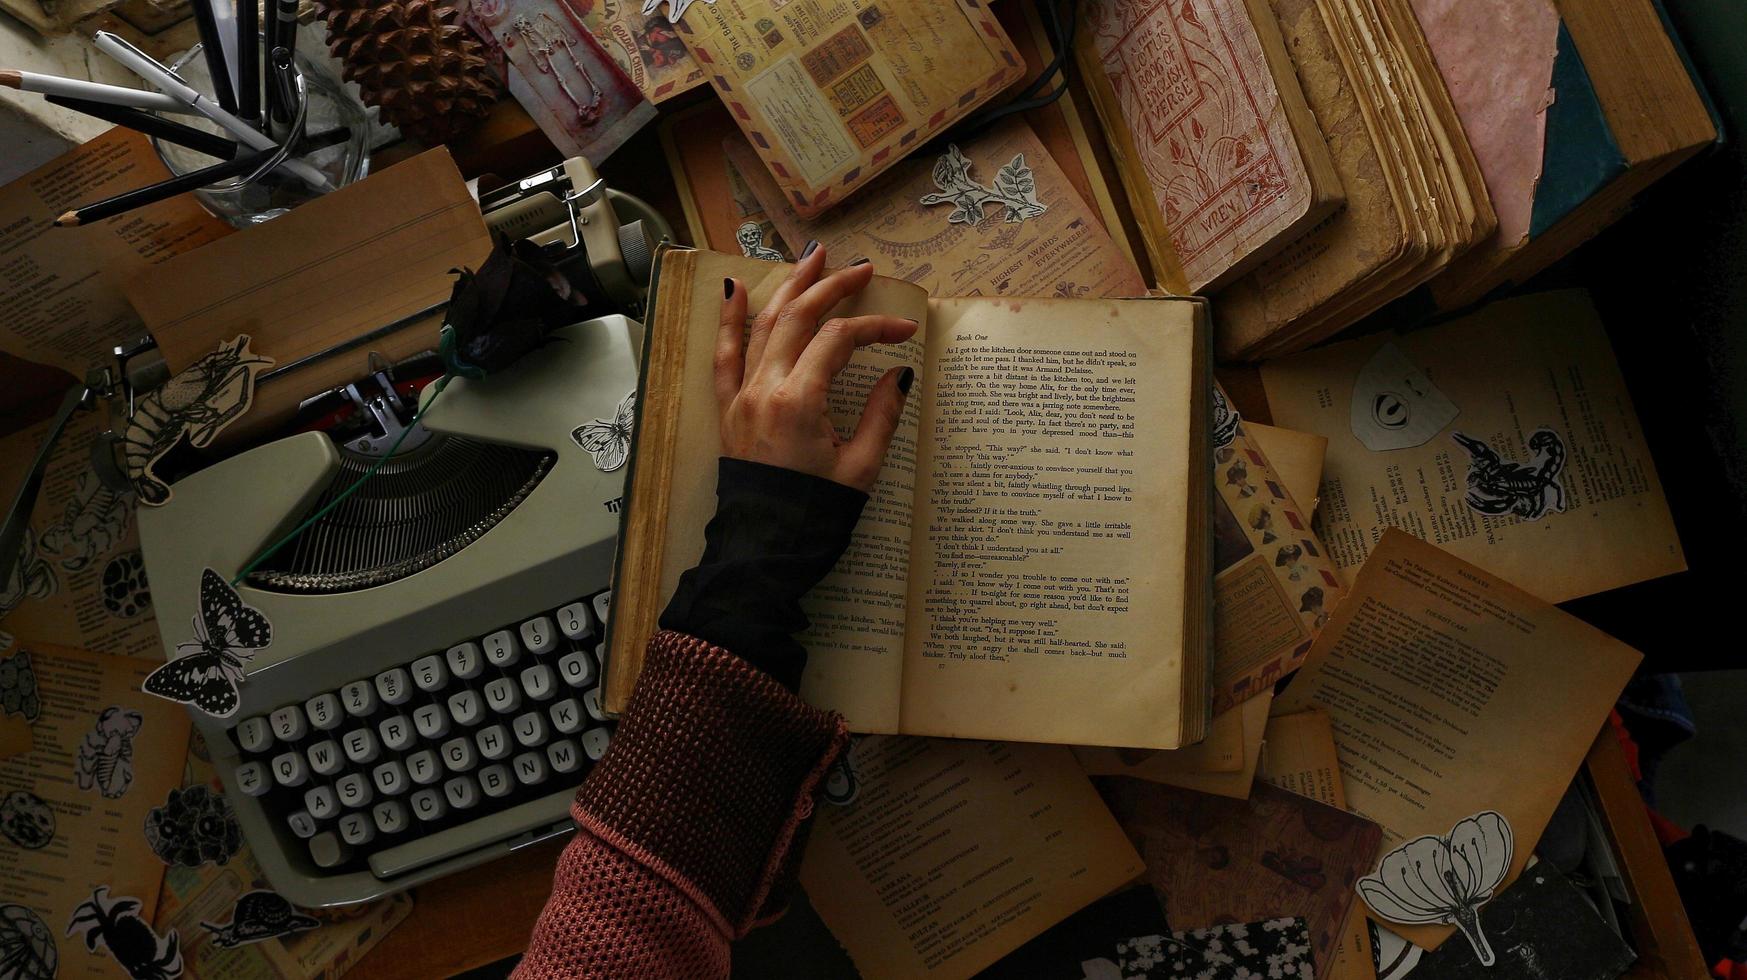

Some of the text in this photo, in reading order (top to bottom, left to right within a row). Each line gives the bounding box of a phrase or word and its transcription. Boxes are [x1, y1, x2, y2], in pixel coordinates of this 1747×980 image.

[612, 25, 636, 56] GOLDEN
[715, 15, 731, 37] BANK
[1137, 28, 1152, 45] THE
[729, 36, 740, 51] THE
[1133, 28, 1171, 73] LOTUS
[1139, 45, 1175, 89] BOOK OF
[1146, 64, 1185, 108] ENGLISH
[1152, 78, 1193, 120] VERSE
[990, 261, 1023, 286] HIGHEST
[1027, 235, 1058, 260] AWARDS
[960, 346, 969, 355] got
[991, 345, 1015, 353] kitchen
[945, 371, 965, 381] Things
[1006, 372, 1027, 380] distant
[1054, 374, 1077, 382] kitchen
[955, 399, 968, 408] ring
[1002, 399, 1019, 407] there
[1042, 401, 1064, 411] jarring
[937, 514, 947, 522] We
[952, 515, 974, 523] walked
[978, 516, 996, 526] along
[1058, 521, 1073, 529] gave
[1104, 521, 1131, 529] irritable
[1481, 514, 1496, 544] SKARD
[925, 596, 957, 606] something
[969, 597, 993, 608] quarrel
[1030, 600, 1046, 610] right
[1107, 604, 1128, 614] expect
[282, 723, 290, 734] 2
[319, 711, 326, 721] 3
[353, 698, 362, 706] 4
[388, 686, 396, 696] 5
[424, 673, 432, 683] 6
[459, 660, 466, 670] 7
[496, 648, 504, 658] 8
[534, 635, 541, 645] 9
[570, 620, 578, 630] 0
[281, 661, 581, 777] Q W E R T Y U I O
[316, 708, 571, 809] A S D F G H J K
[348, 748, 569, 836] Z X C V B N M
